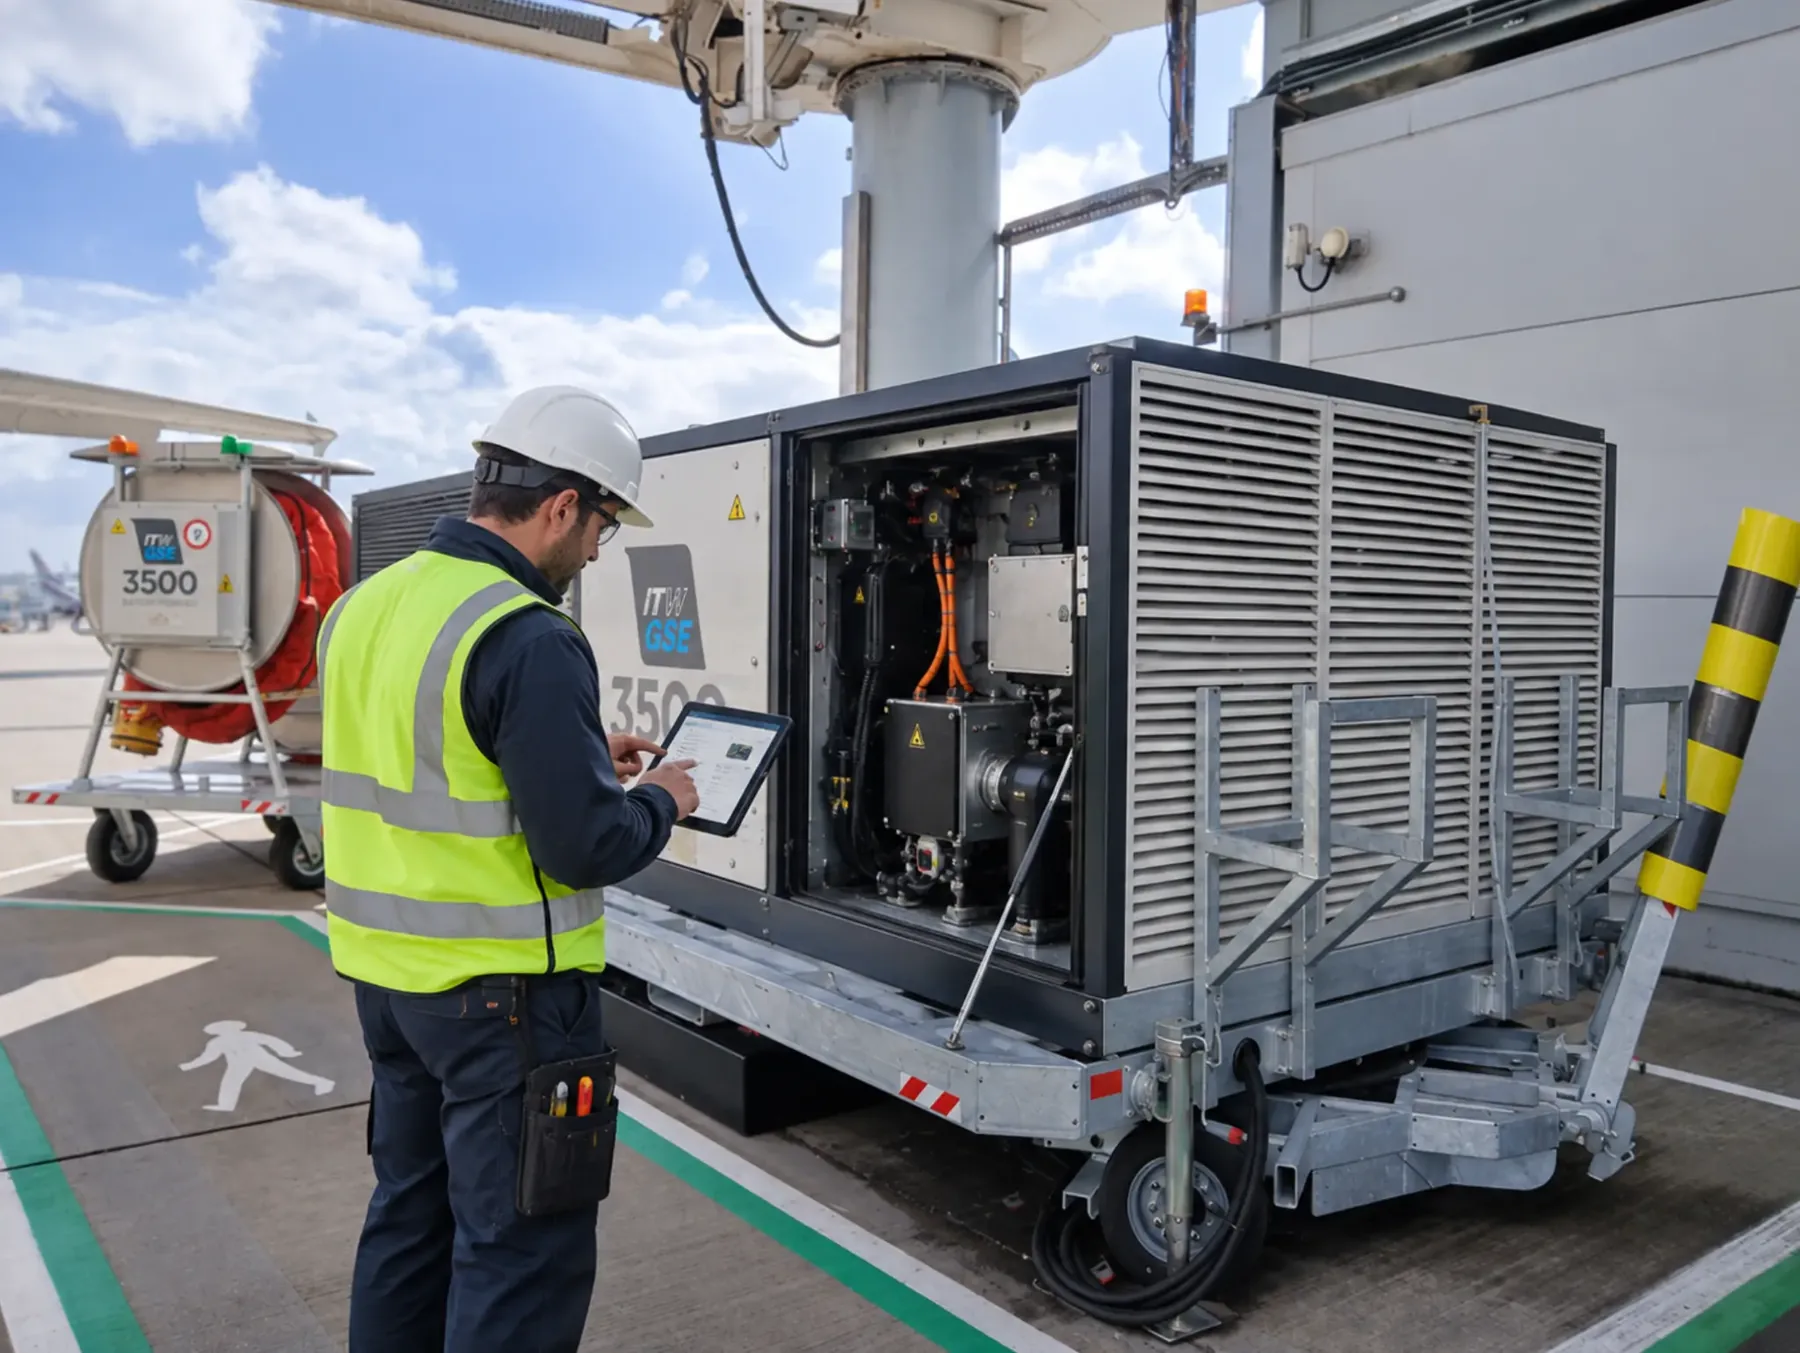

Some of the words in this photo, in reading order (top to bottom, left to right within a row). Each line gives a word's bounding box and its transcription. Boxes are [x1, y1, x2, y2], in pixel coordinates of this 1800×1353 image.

[143, 534, 174, 546] ITW
[122, 569, 198, 595] 3500
[643, 587, 688, 617] ITW
[645, 619, 693, 654] GSE
